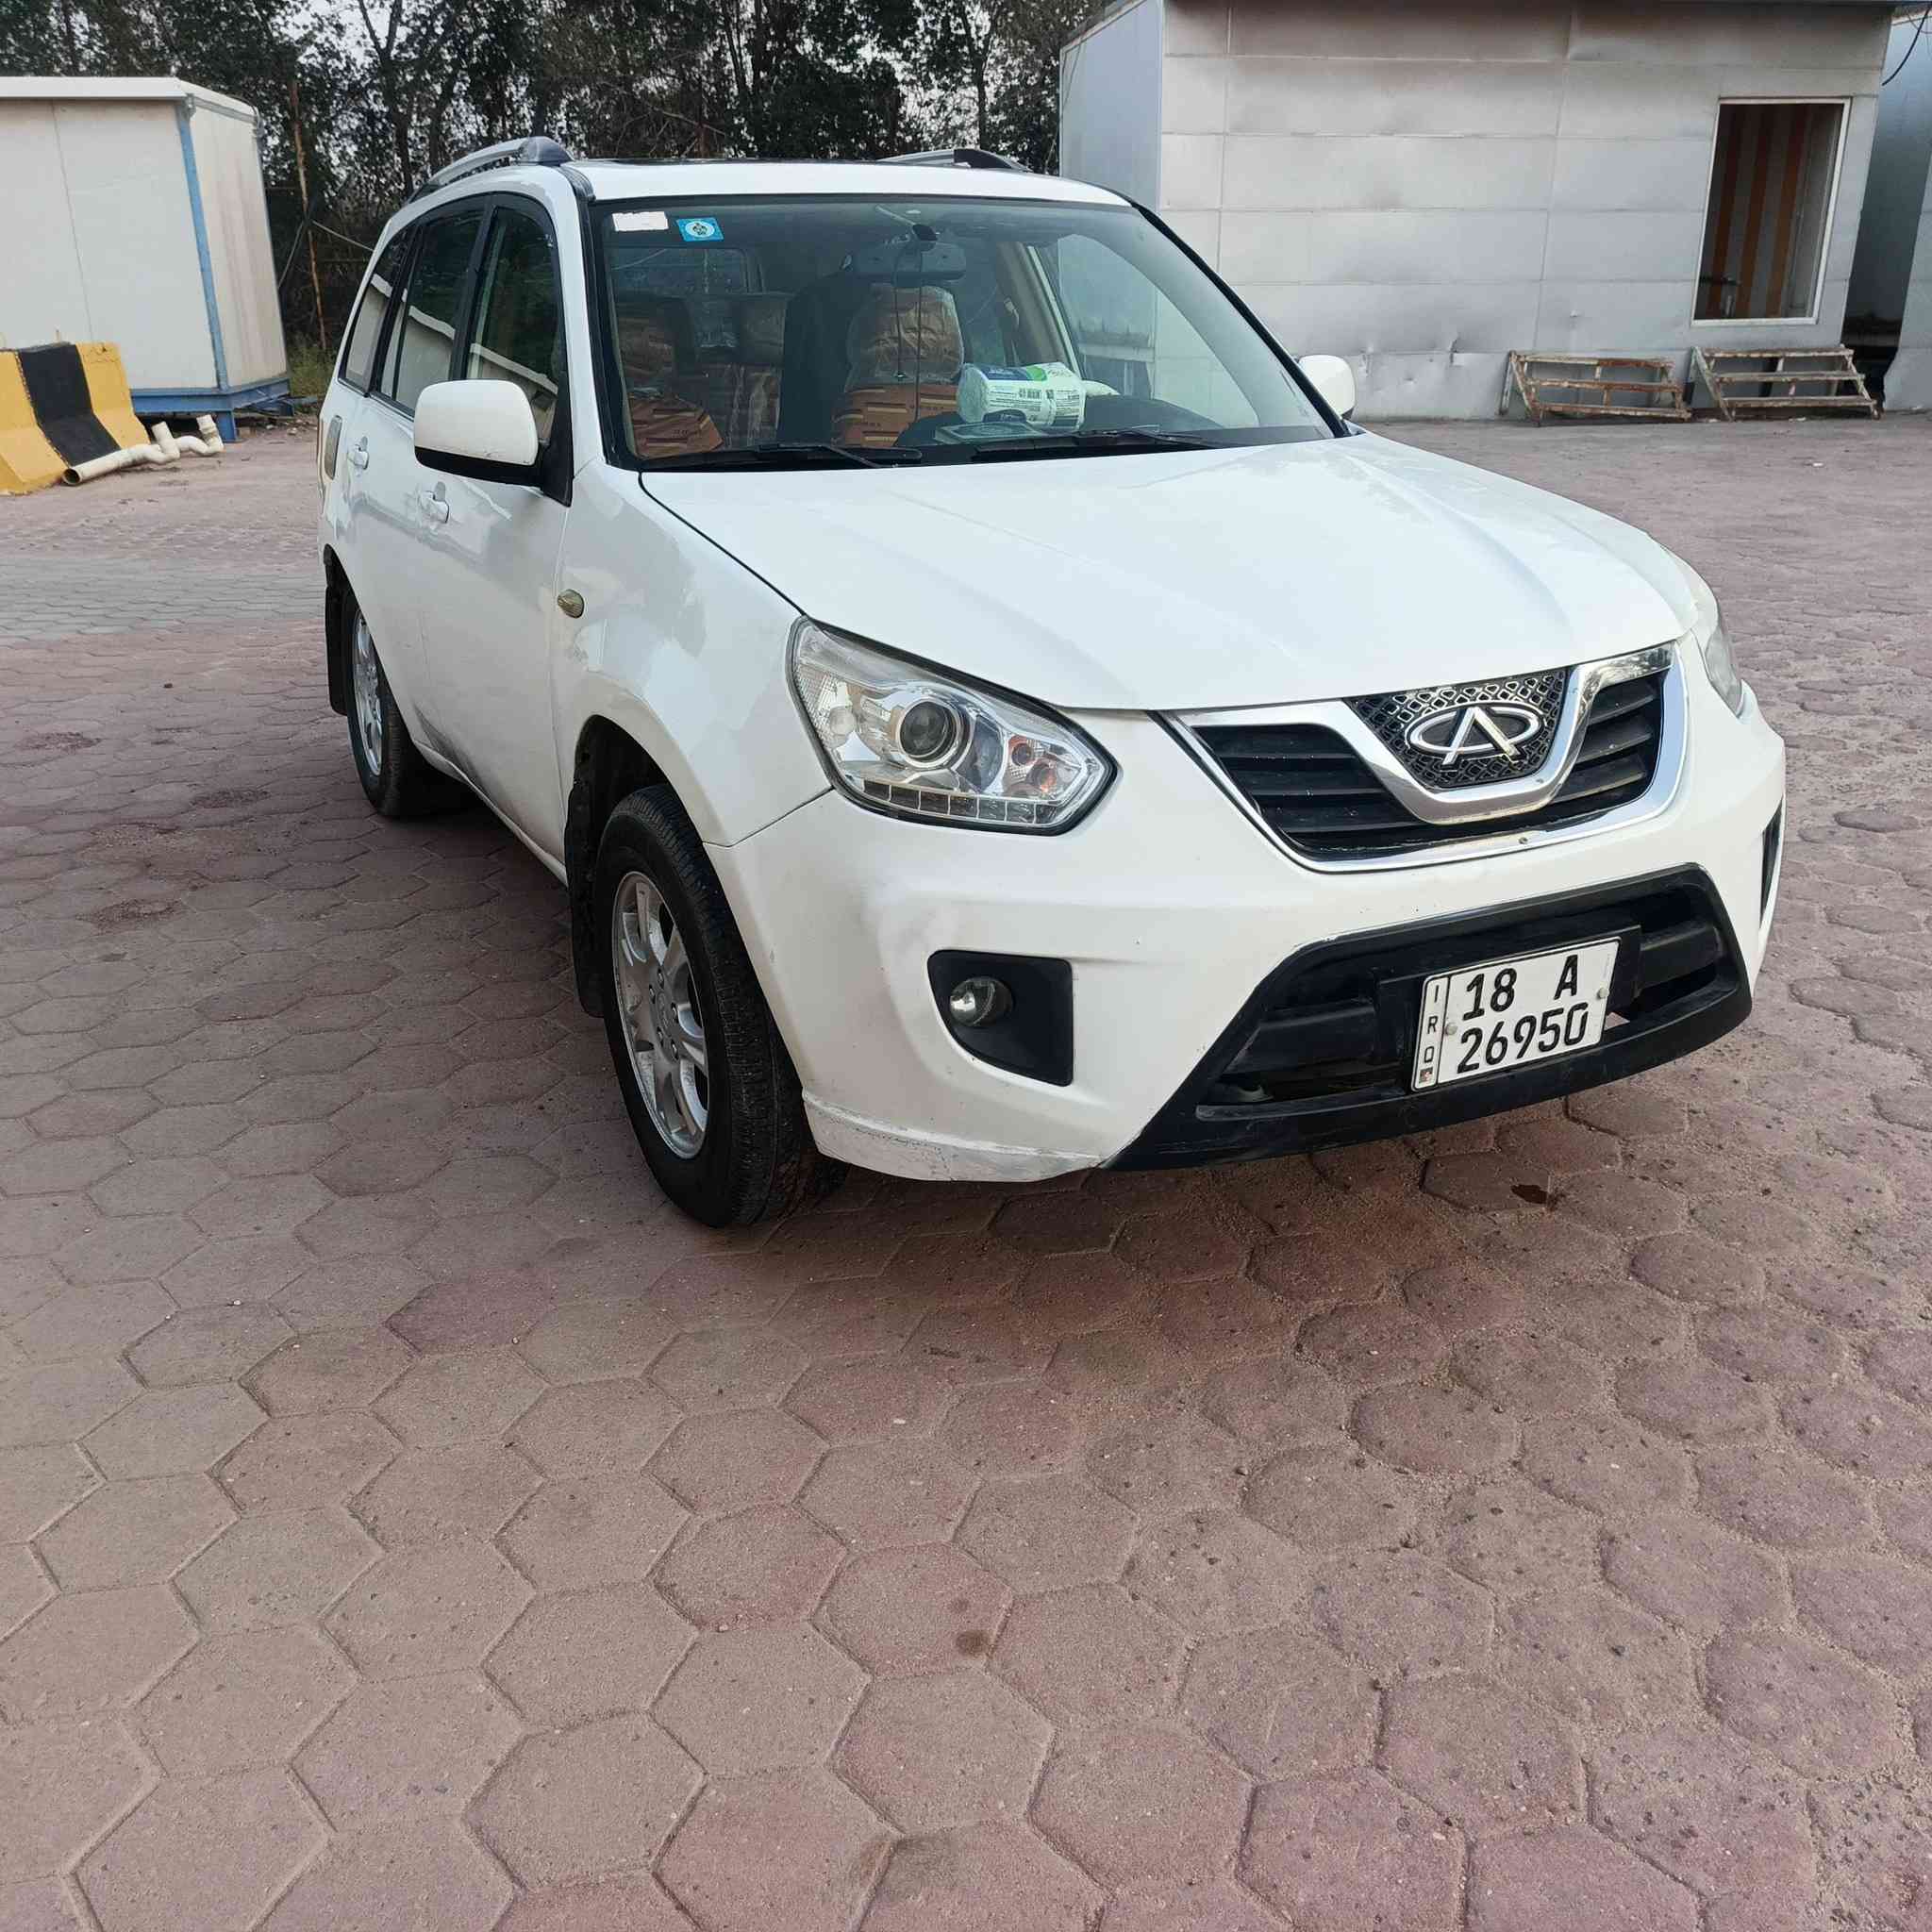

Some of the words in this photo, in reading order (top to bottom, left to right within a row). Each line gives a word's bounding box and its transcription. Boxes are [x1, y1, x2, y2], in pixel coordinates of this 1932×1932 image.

[1462, 968, 1517, 1021] 18
[1554, 955, 1578, 1000] A
[1457, 1002, 1589, 1074] 26950
